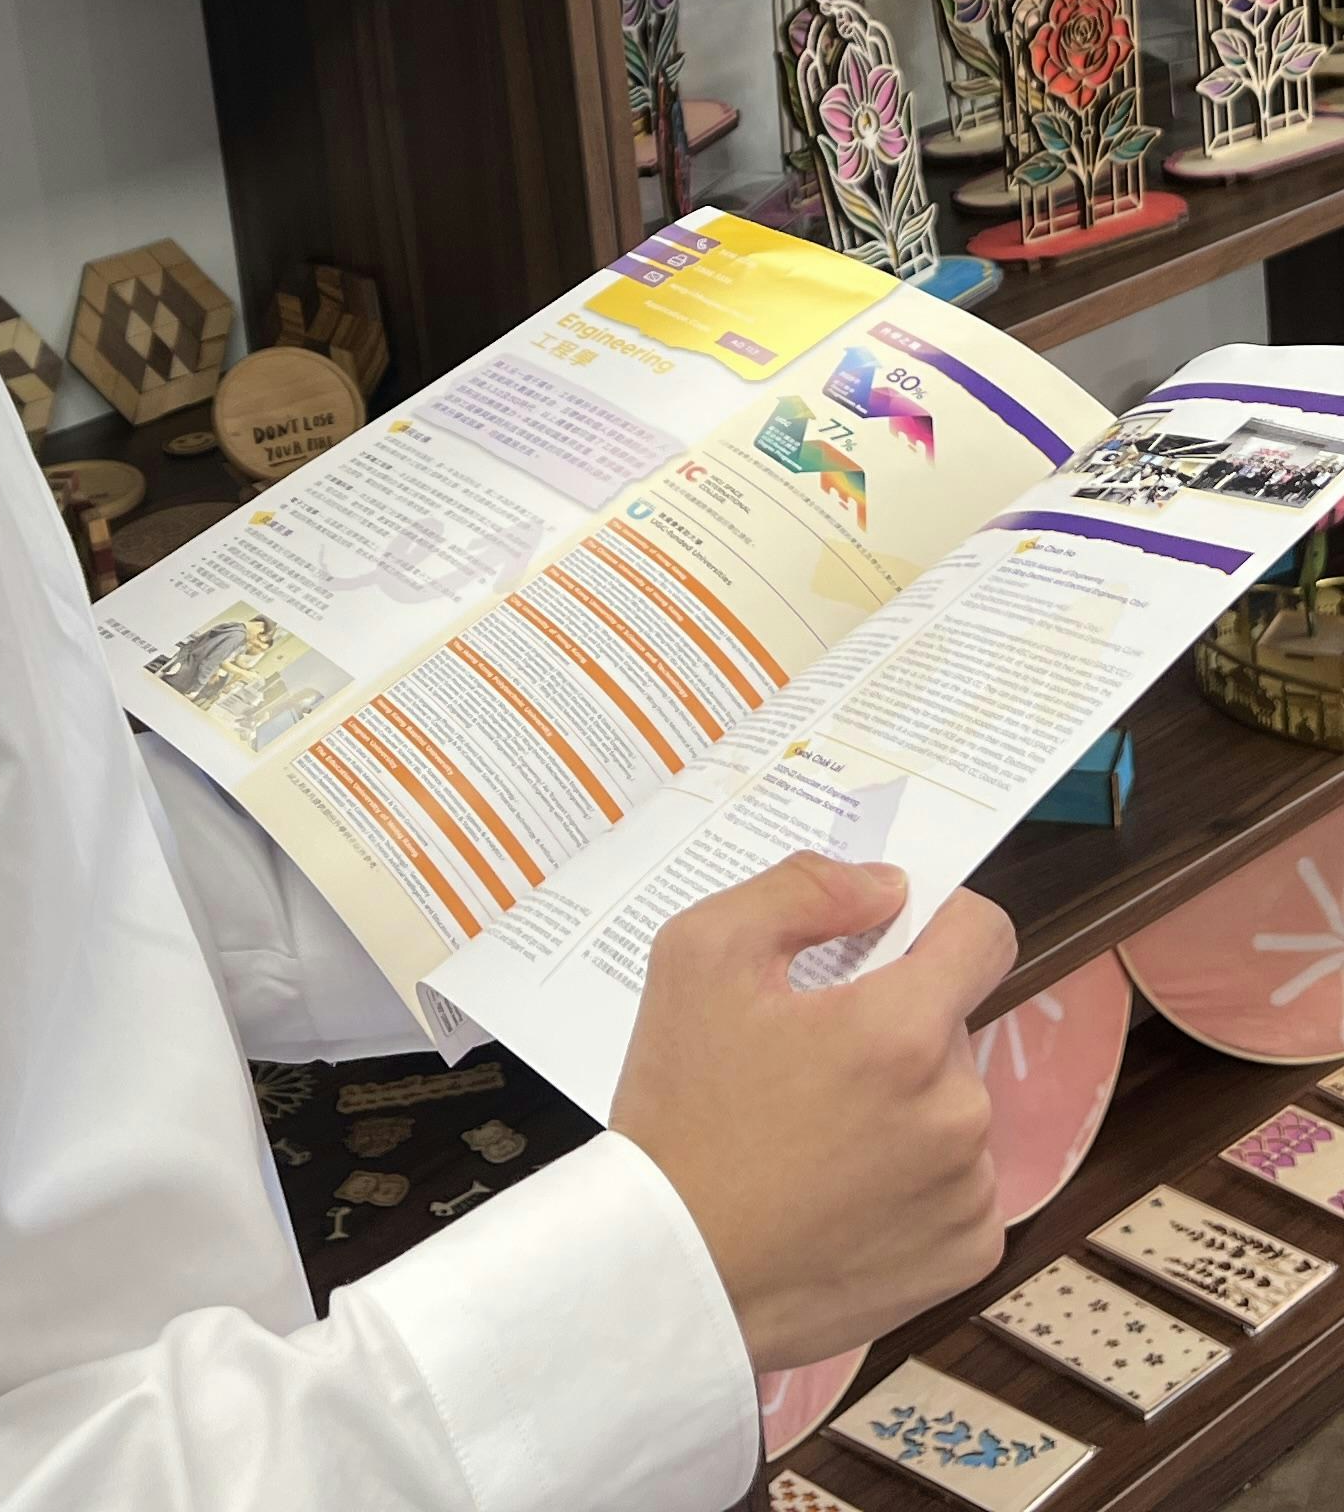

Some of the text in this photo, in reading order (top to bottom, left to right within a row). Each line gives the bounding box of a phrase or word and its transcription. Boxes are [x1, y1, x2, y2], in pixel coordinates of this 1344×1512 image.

[530, 330, 599, 369] 工程學
[557, 311, 676, 375] Engineering
[885, 367, 928, 400] 80%
[818, 418, 858, 452] 77%
